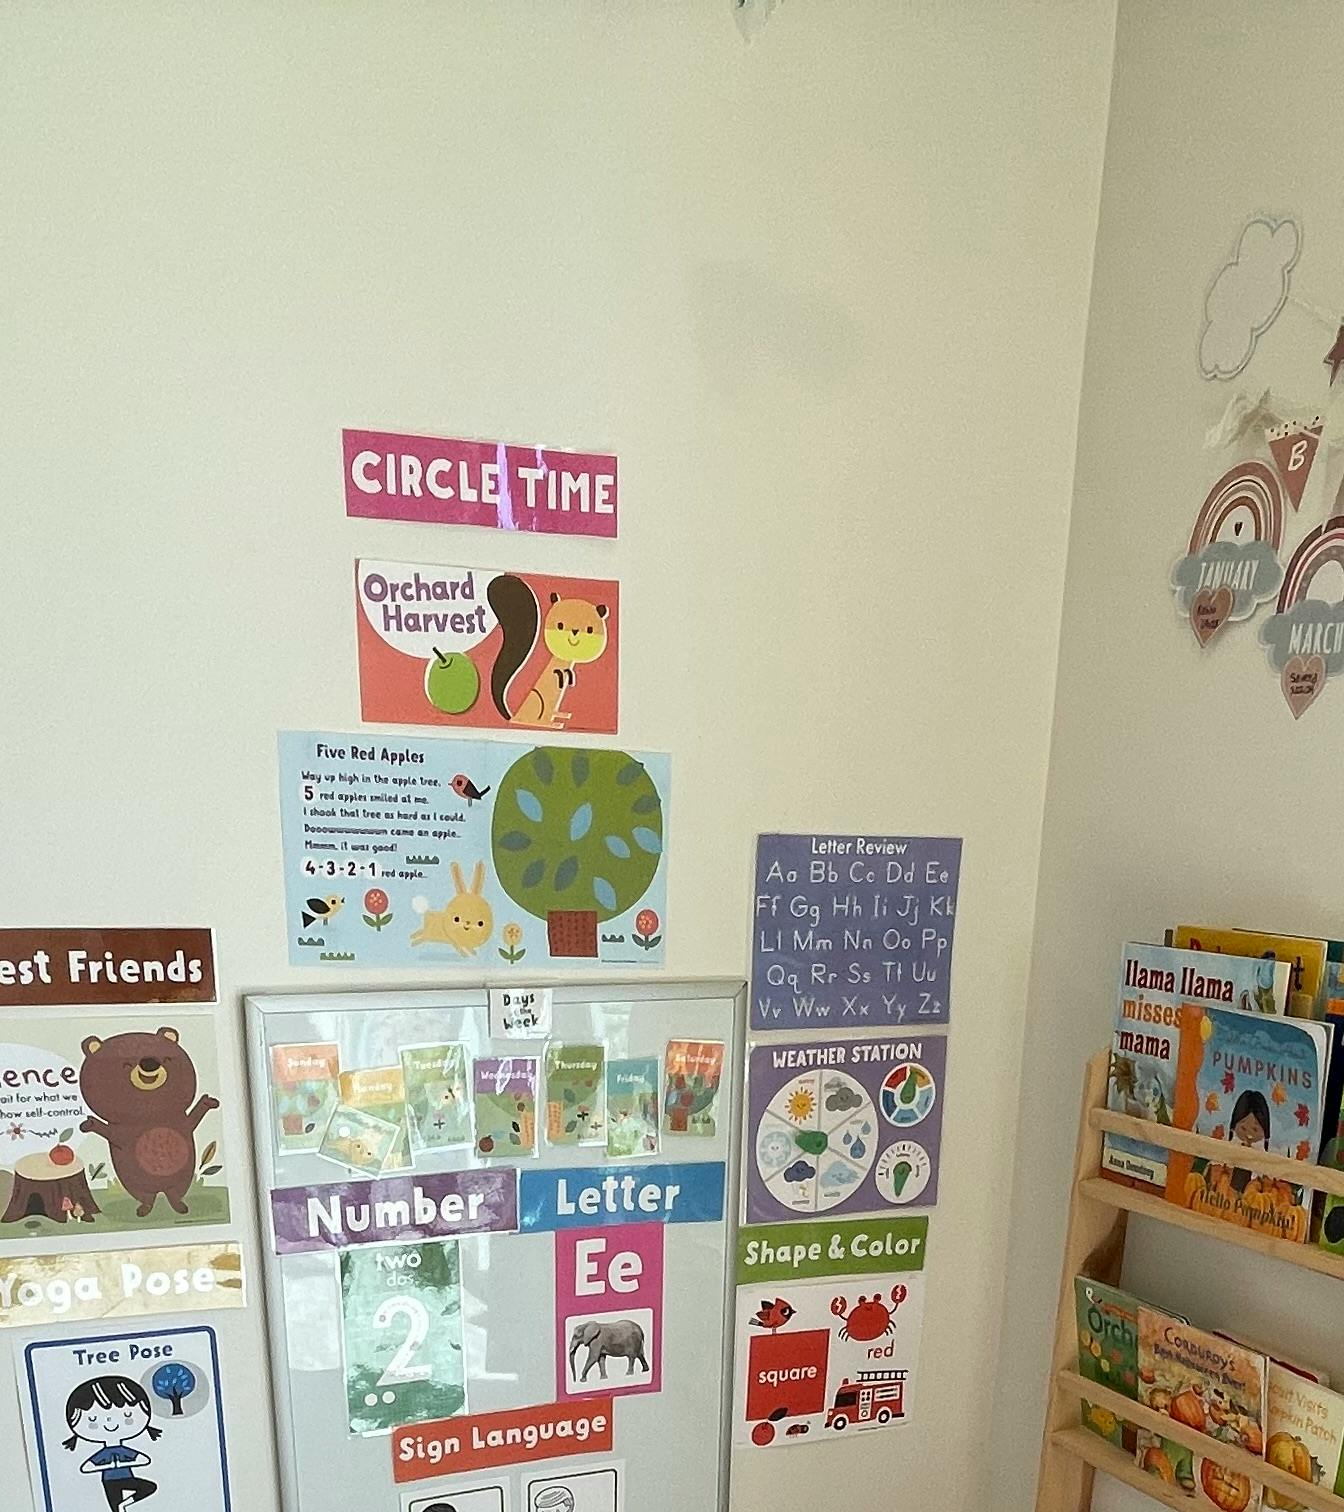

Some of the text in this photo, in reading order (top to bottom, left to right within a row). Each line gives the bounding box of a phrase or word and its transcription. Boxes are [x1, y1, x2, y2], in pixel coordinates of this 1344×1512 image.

[351, 450, 614, 514] CIRCLE TIME
[364, 571, 474, 602] Orchard
[383, 604, 487, 634] Harvest
[1288, 621, 1343, 655] MARCH
[316, 744, 424, 765] Five Red Apples
[302, 771, 321, 783] Way
[324, 775, 335, 784] up
[339, 772, 358, 785] high
[361, 774, 371, 783] in
[374, 775, 388, 784] the
[392, 777, 416, 787] apple
[304, 786, 412, 803] 5 red apples smiled at
[310, 808, 336, 817] shook
[340, 809, 359, 818] that
[363, 809, 381, 819] tree
[397, 811, 418, 820] hard
[811, 837, 907, 855] Letter Review
[306, 860, 395, 877] 4 3 2 1 red
[68, 950, 202, 984] Friends
[1124, 958, 1233, 1002] llama llama
[503, 993, 534, 1007] Days
[773, 1043, 922, 1068] WEATHER STATION
[1118, 1032, 1170, 1060] mama
[287, 1056, 326, 1069] Sunday
[555, 1060, 597, 1072] Thursday
[673, 1052, 718, 1066] Saturday
[1212, 1050, 1312, 1089] PUMPKINS
[617, 1074, 644, 1086] Friday
[16, 1093, 31, 1104] for
[35, 1093, 60, 1102] what
[63, 1094, 78, 1102] we
[558, 1175, 679, 1215] Letter
[1200, 1187, 1231, 1209] Hello
[307, 1186, 484, 1237] Number
[744, 1232, 920, 1267] Shape & Color
[375, 1251, 422, 1271] two
[574, 1238, 642, 1296] Ee
[121, 1263, 215, 1298] Pose
[386, 1273, 414, 1286] dos
[372, 1296, 433, 1386] 2
[867, 1339, 895, 1359] red
[73, 1344, 173, 1366] Tree Pose
[758, 1365, 817, 1386] square
[398, 1413, 606, 1464] Sign Language
